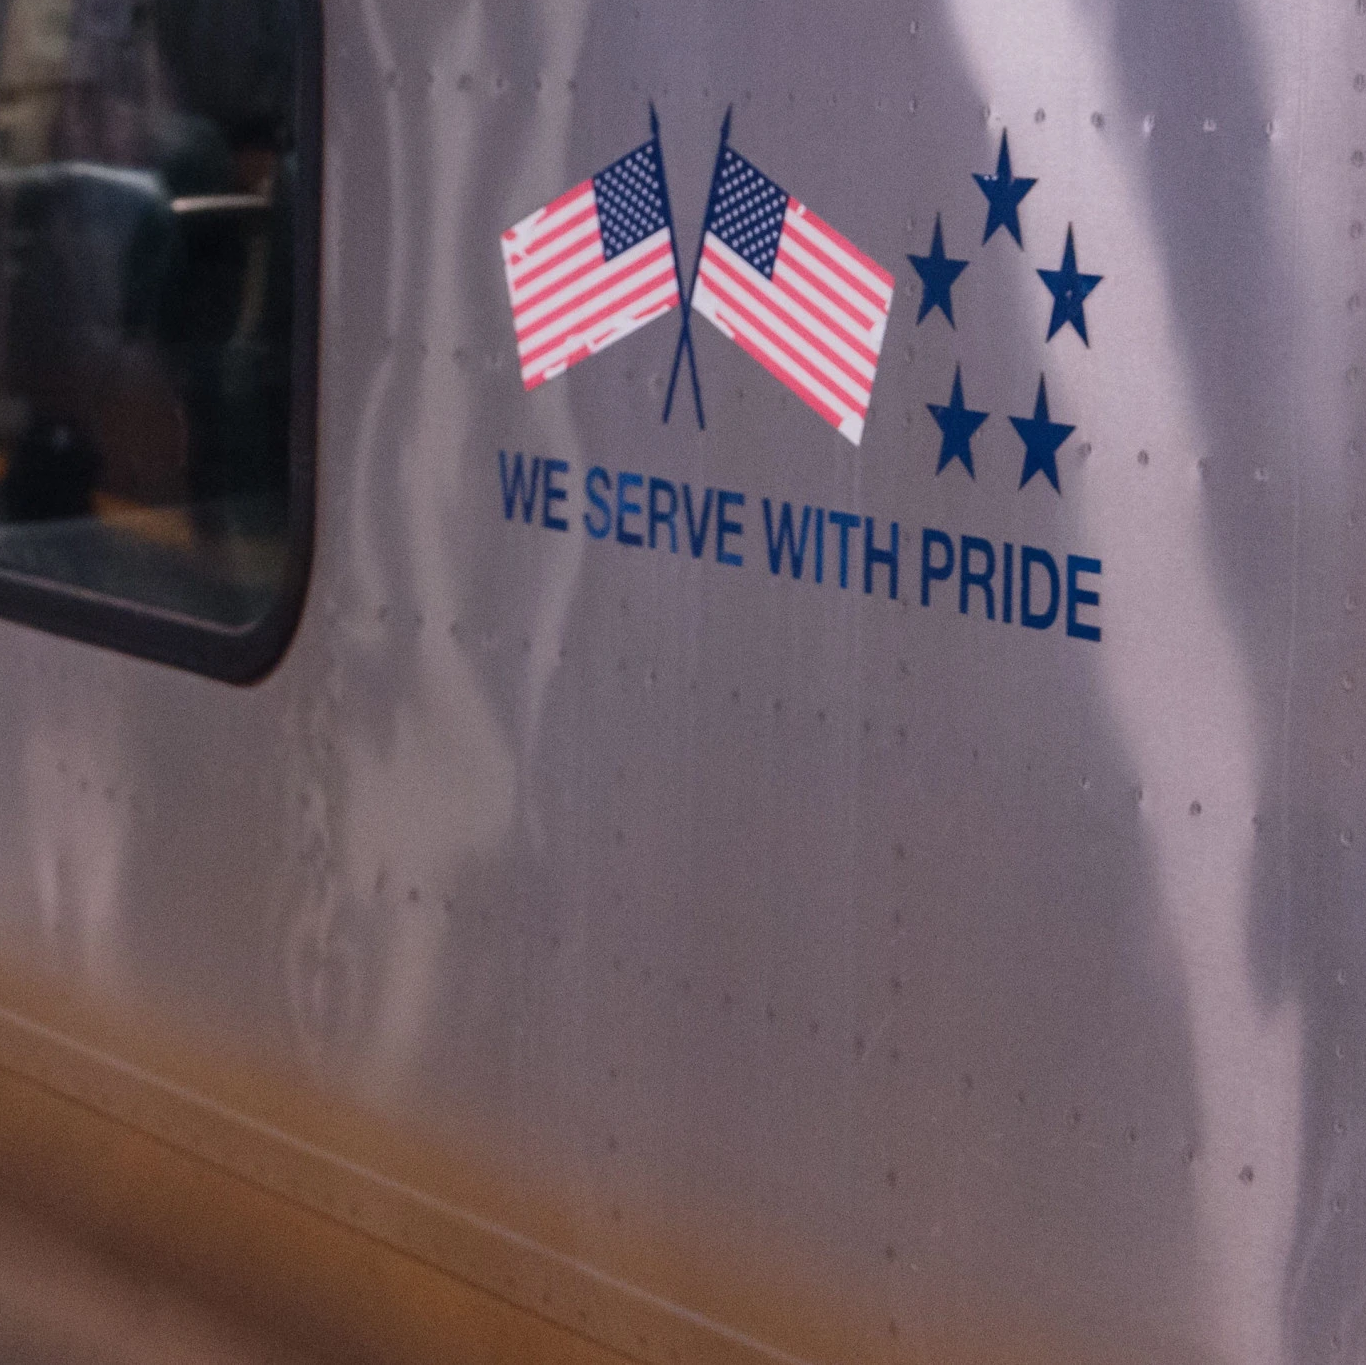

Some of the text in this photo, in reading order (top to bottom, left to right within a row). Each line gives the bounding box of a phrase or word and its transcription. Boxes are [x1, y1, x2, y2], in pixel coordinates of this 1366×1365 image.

[498, 450, 1103, 642] WE SERVE WITH PRIDE
